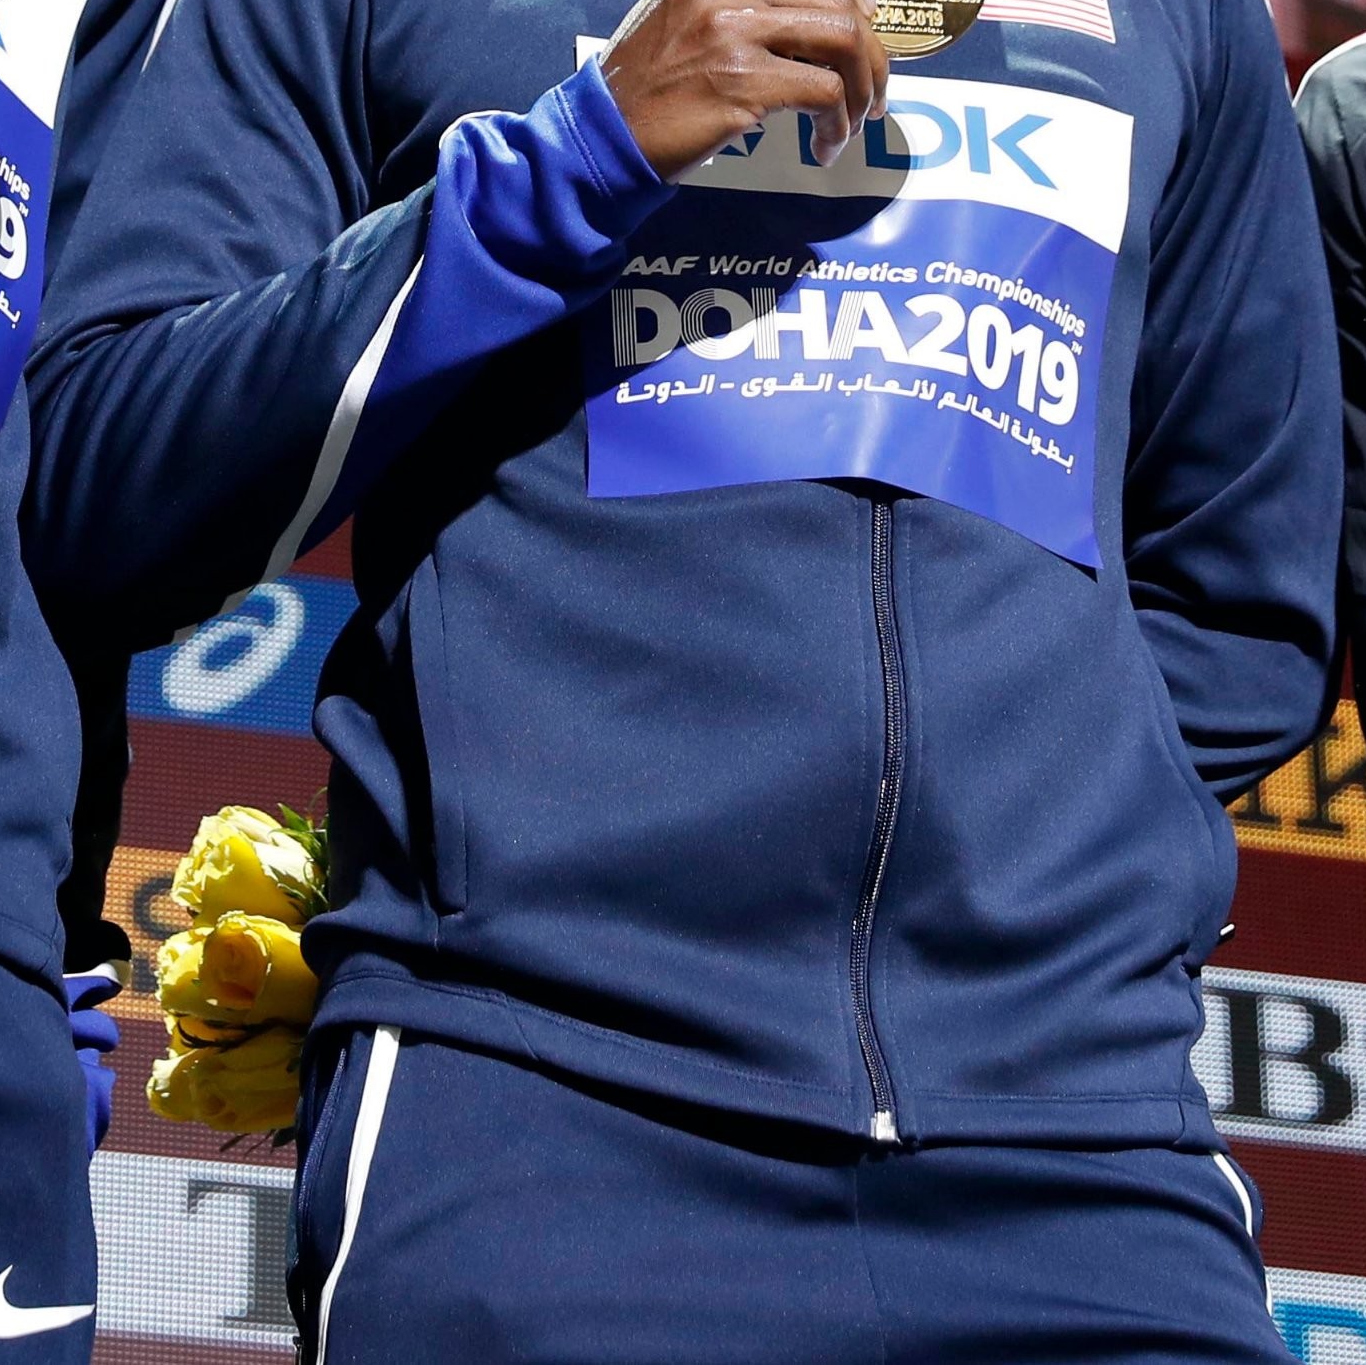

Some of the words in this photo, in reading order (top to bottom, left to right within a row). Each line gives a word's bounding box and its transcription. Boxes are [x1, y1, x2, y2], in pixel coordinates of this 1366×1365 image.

[708, 254, 793, 277] World
[796, 259, 919, 284] Athletics
[924, 260, 1086, 339] Championships
[610, 286, 1080, 427] DOHA2019
[615, 373, 716, 405] الدوحة
[936, 391, 1011, 434] العالم
[1010, 418, 1075, 475] بطولة
